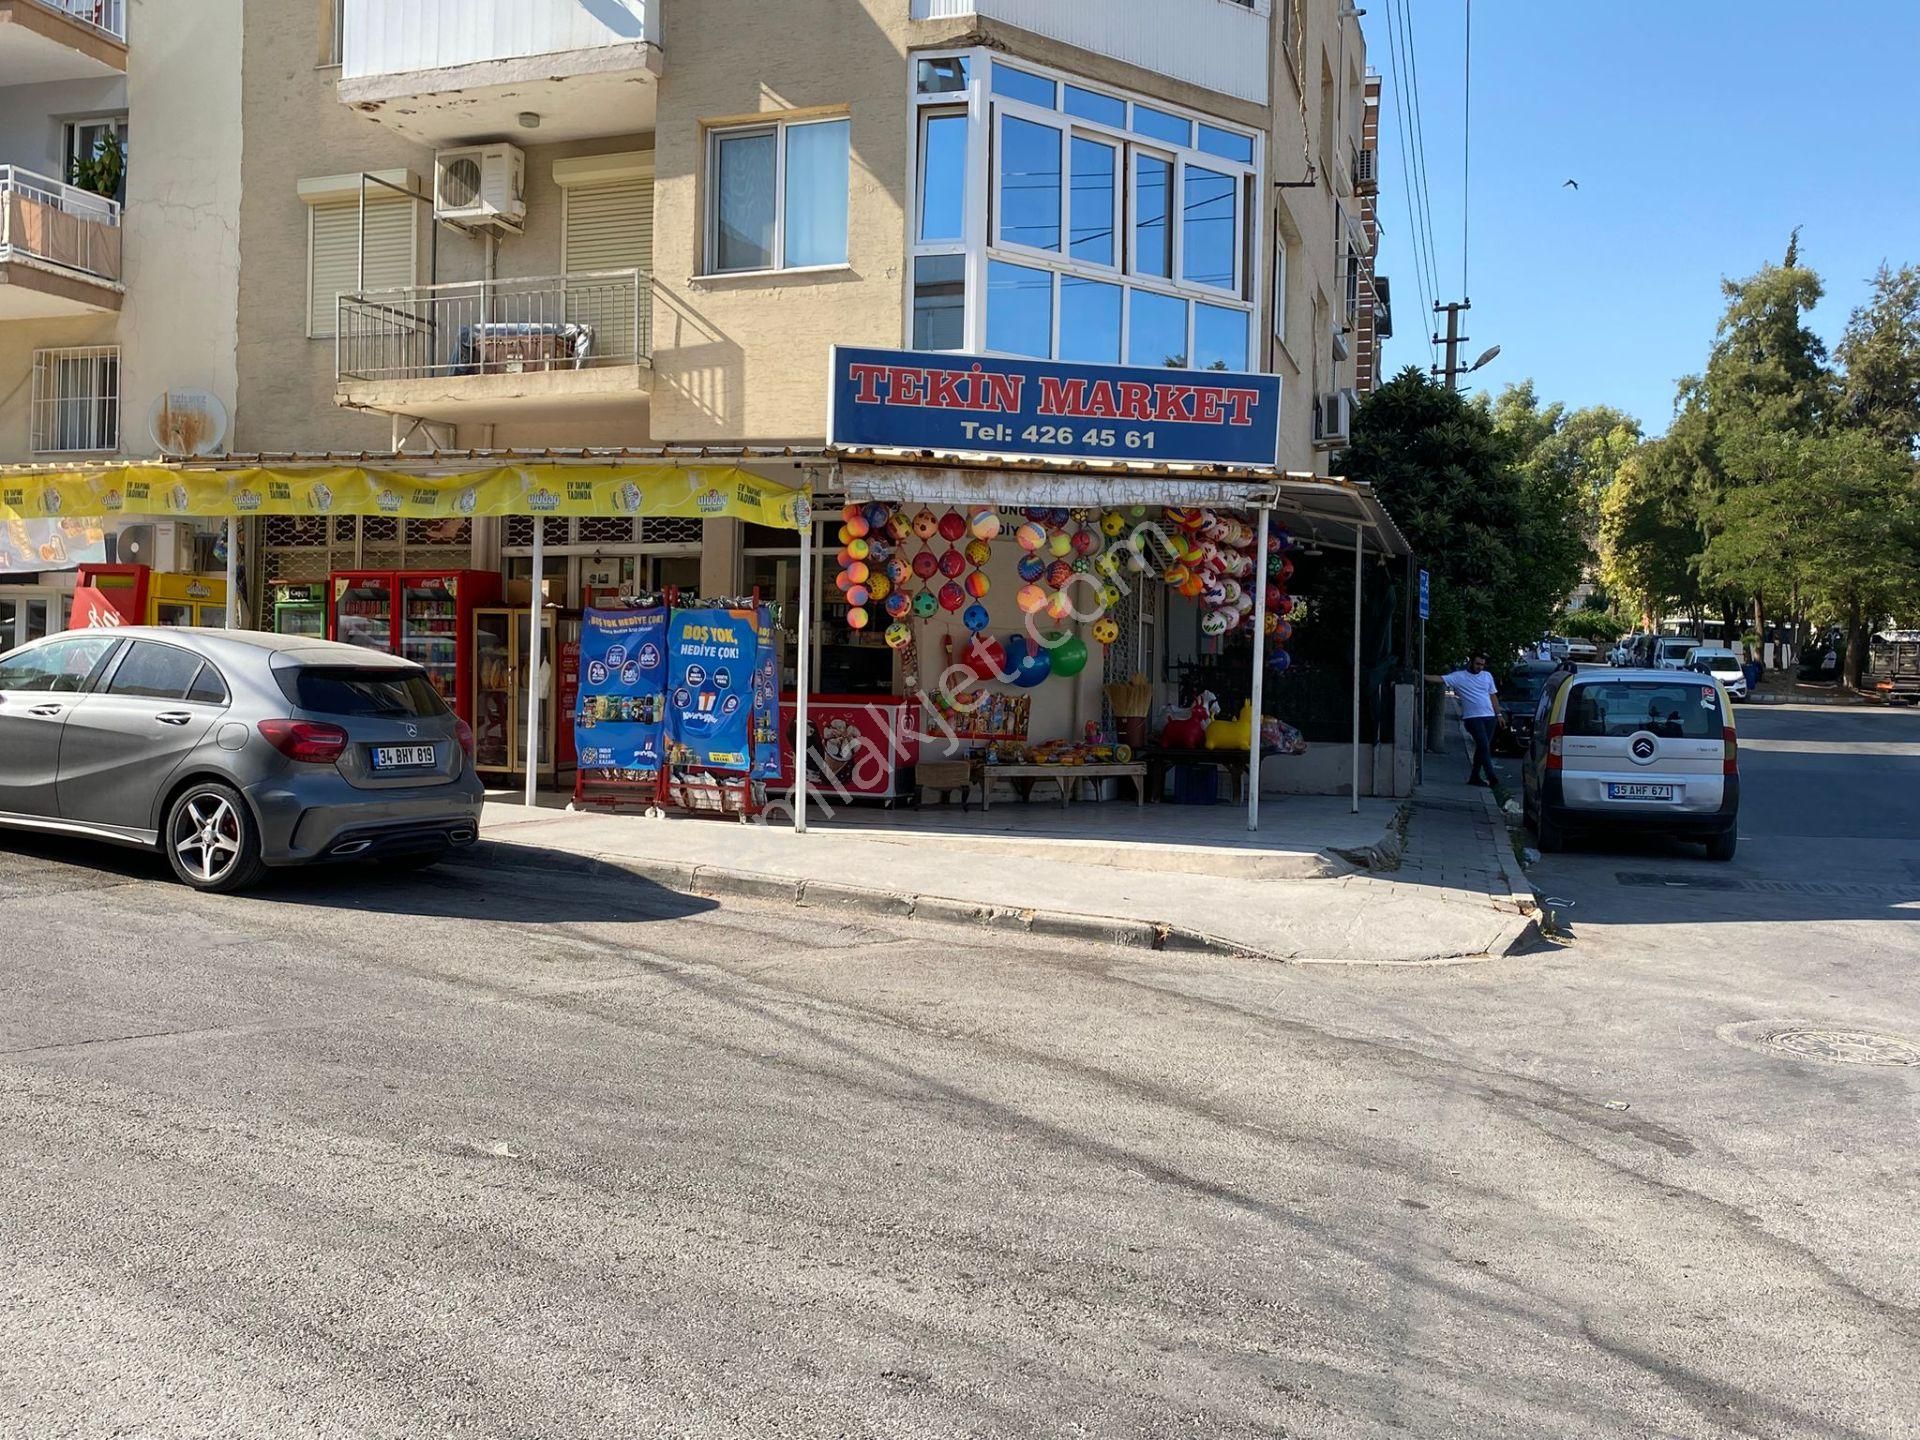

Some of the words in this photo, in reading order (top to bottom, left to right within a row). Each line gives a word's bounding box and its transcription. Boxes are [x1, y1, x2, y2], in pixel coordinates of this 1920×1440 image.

[849, 362, 1025, 414] TEKİN
[1037, 376, 1260, 426] MARKET
[961, 421, 1013, 442] Tel:
[1021, 424, 1074, 445] 426
[1082, 427, 1116, 447] 45
[1125, 430, 1155, 449] 61
[682, 624, 709, 644] BOŞ
[710, 627, 739, 646] YOK,
[680, 644, 717, 657] HEDİYE
[717, 646, 739, 660] ÇOK!
[380, 749, 393, 764] 34
[396, 748, 414, 763] BHY
[417, 747, 433, 762] 819
[1614, 785, 1627, 795] 35
[1629, 786, 1648, 795] AHF
